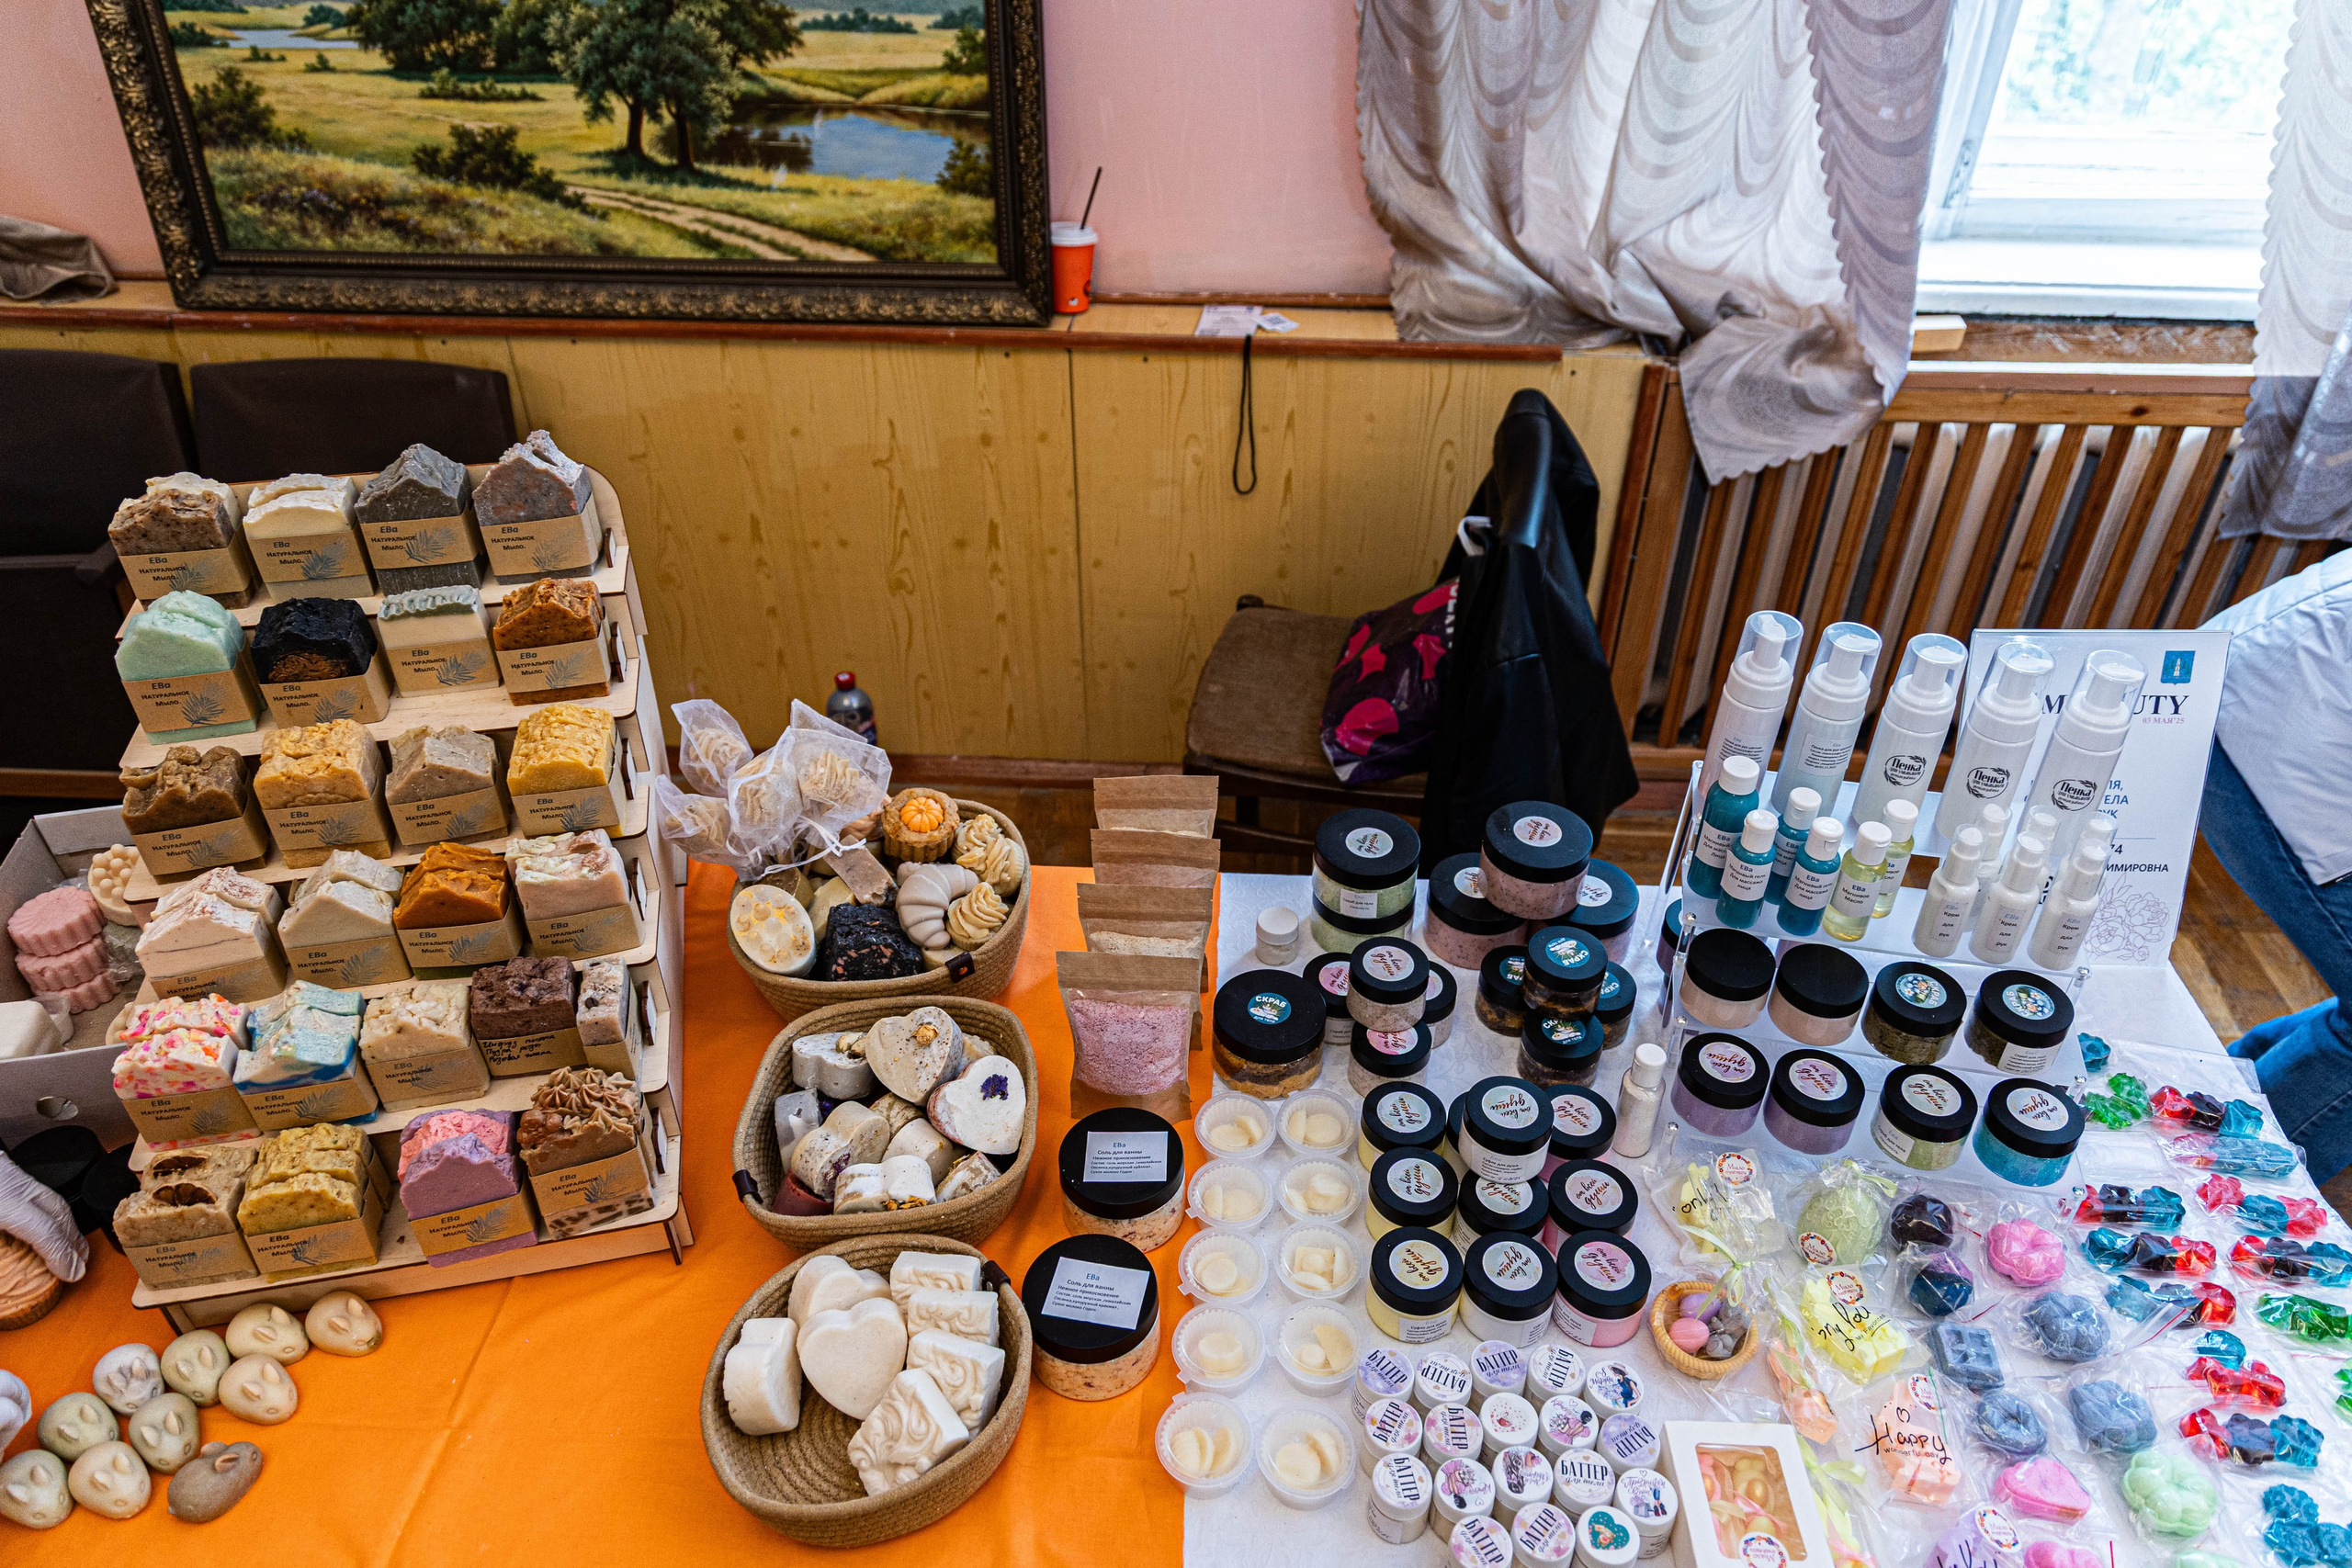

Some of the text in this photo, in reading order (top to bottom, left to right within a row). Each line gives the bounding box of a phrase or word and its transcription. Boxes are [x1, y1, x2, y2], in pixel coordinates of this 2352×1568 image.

[1892, 758, 1922, 772] Пенка
[1974, 770, 2005, 784] Пенка
[2062, 782, 2092, 796] Пенка
[2103, 795, 2128, 805] ЕЛА
[1740, 864, 1753, 873] ЕВа
[1562, 950, 1588, 965] СКРАБ
[1256, 996, 1286, 1008] СКРАБ
[1929, 980, 1938, 1006] СКРАБ
[1057, 1285, 1079, 1293] Нежное
[1863, 1314, 1885, 1334] Favorites
[1367, 1349, 1408, 1384] БАТТЕР
[1476, 1349, 1518, 1372] БАТТЕР
[1548, 1348, 1574, 1388] БАТТЕР
[1373, 1402, 1405, 1443] БАТТЕР
[1855, 1415, 1952, 1465] Happy
[1394, 1457, 1420, 1501] БАТТЕР
[1562, 1460, 1608, 1481] БАТТЕР
[1520, 1507, 1557, 1551] БАТТЕР
